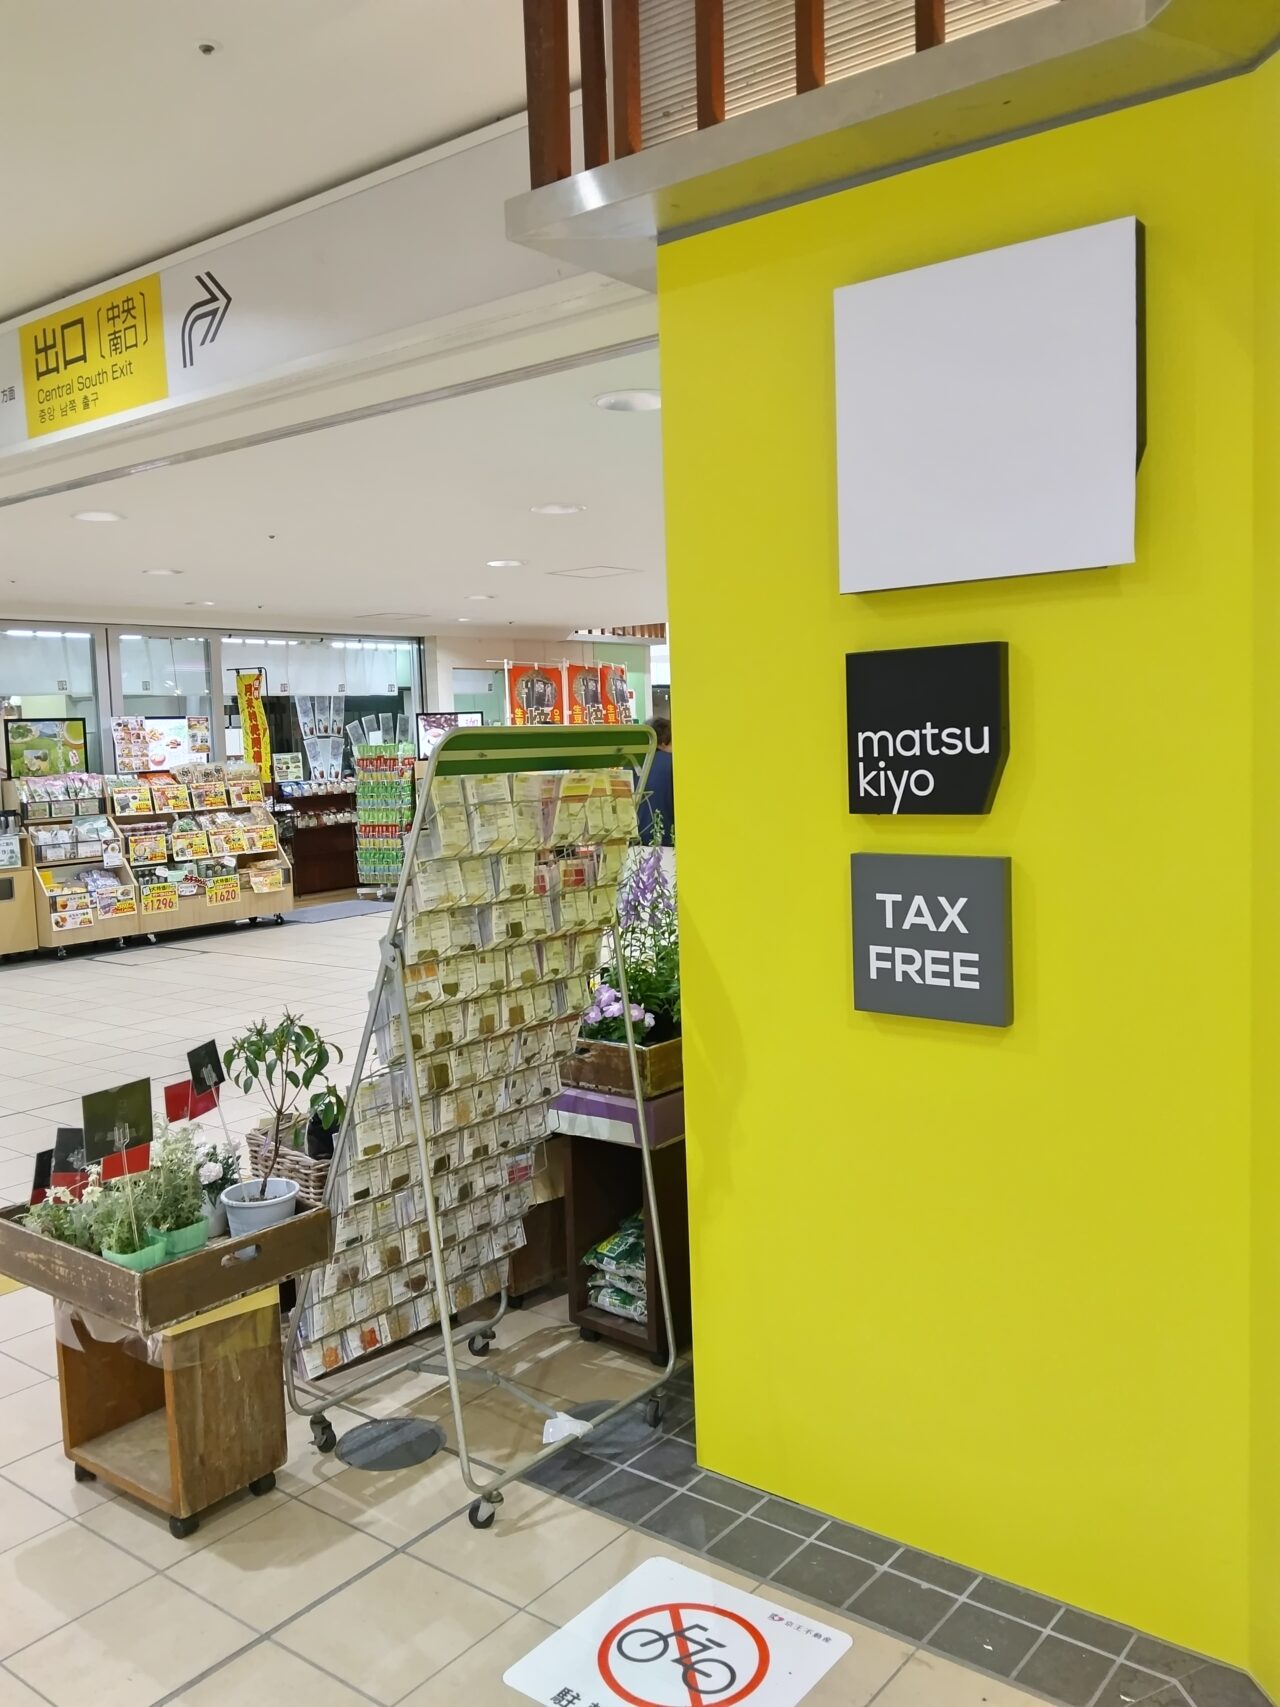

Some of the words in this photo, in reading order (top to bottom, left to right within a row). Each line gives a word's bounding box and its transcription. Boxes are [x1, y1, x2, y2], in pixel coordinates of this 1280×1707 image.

[106, 296, 137, 327] 中央
[34, 317, 87, 381] 出口
[107, 324, 139, 358] 南口
[0, 386, 16, 403] 方面
[37, 378, 74, 405] Central
[77, 369, 108, 392] South
[112, 360, 134, 381] Exit
[38, 406, 55, 424] 중앙
[60, 399, 77, 417] 남쪽
[82, 392, 99, 411] 출구
[857, 722, 990, 758] matsu
[858, 761, 935, 814] kiyo
[875, 892, 969, 934] TAX
[868, 944, 980, 990] FREE
